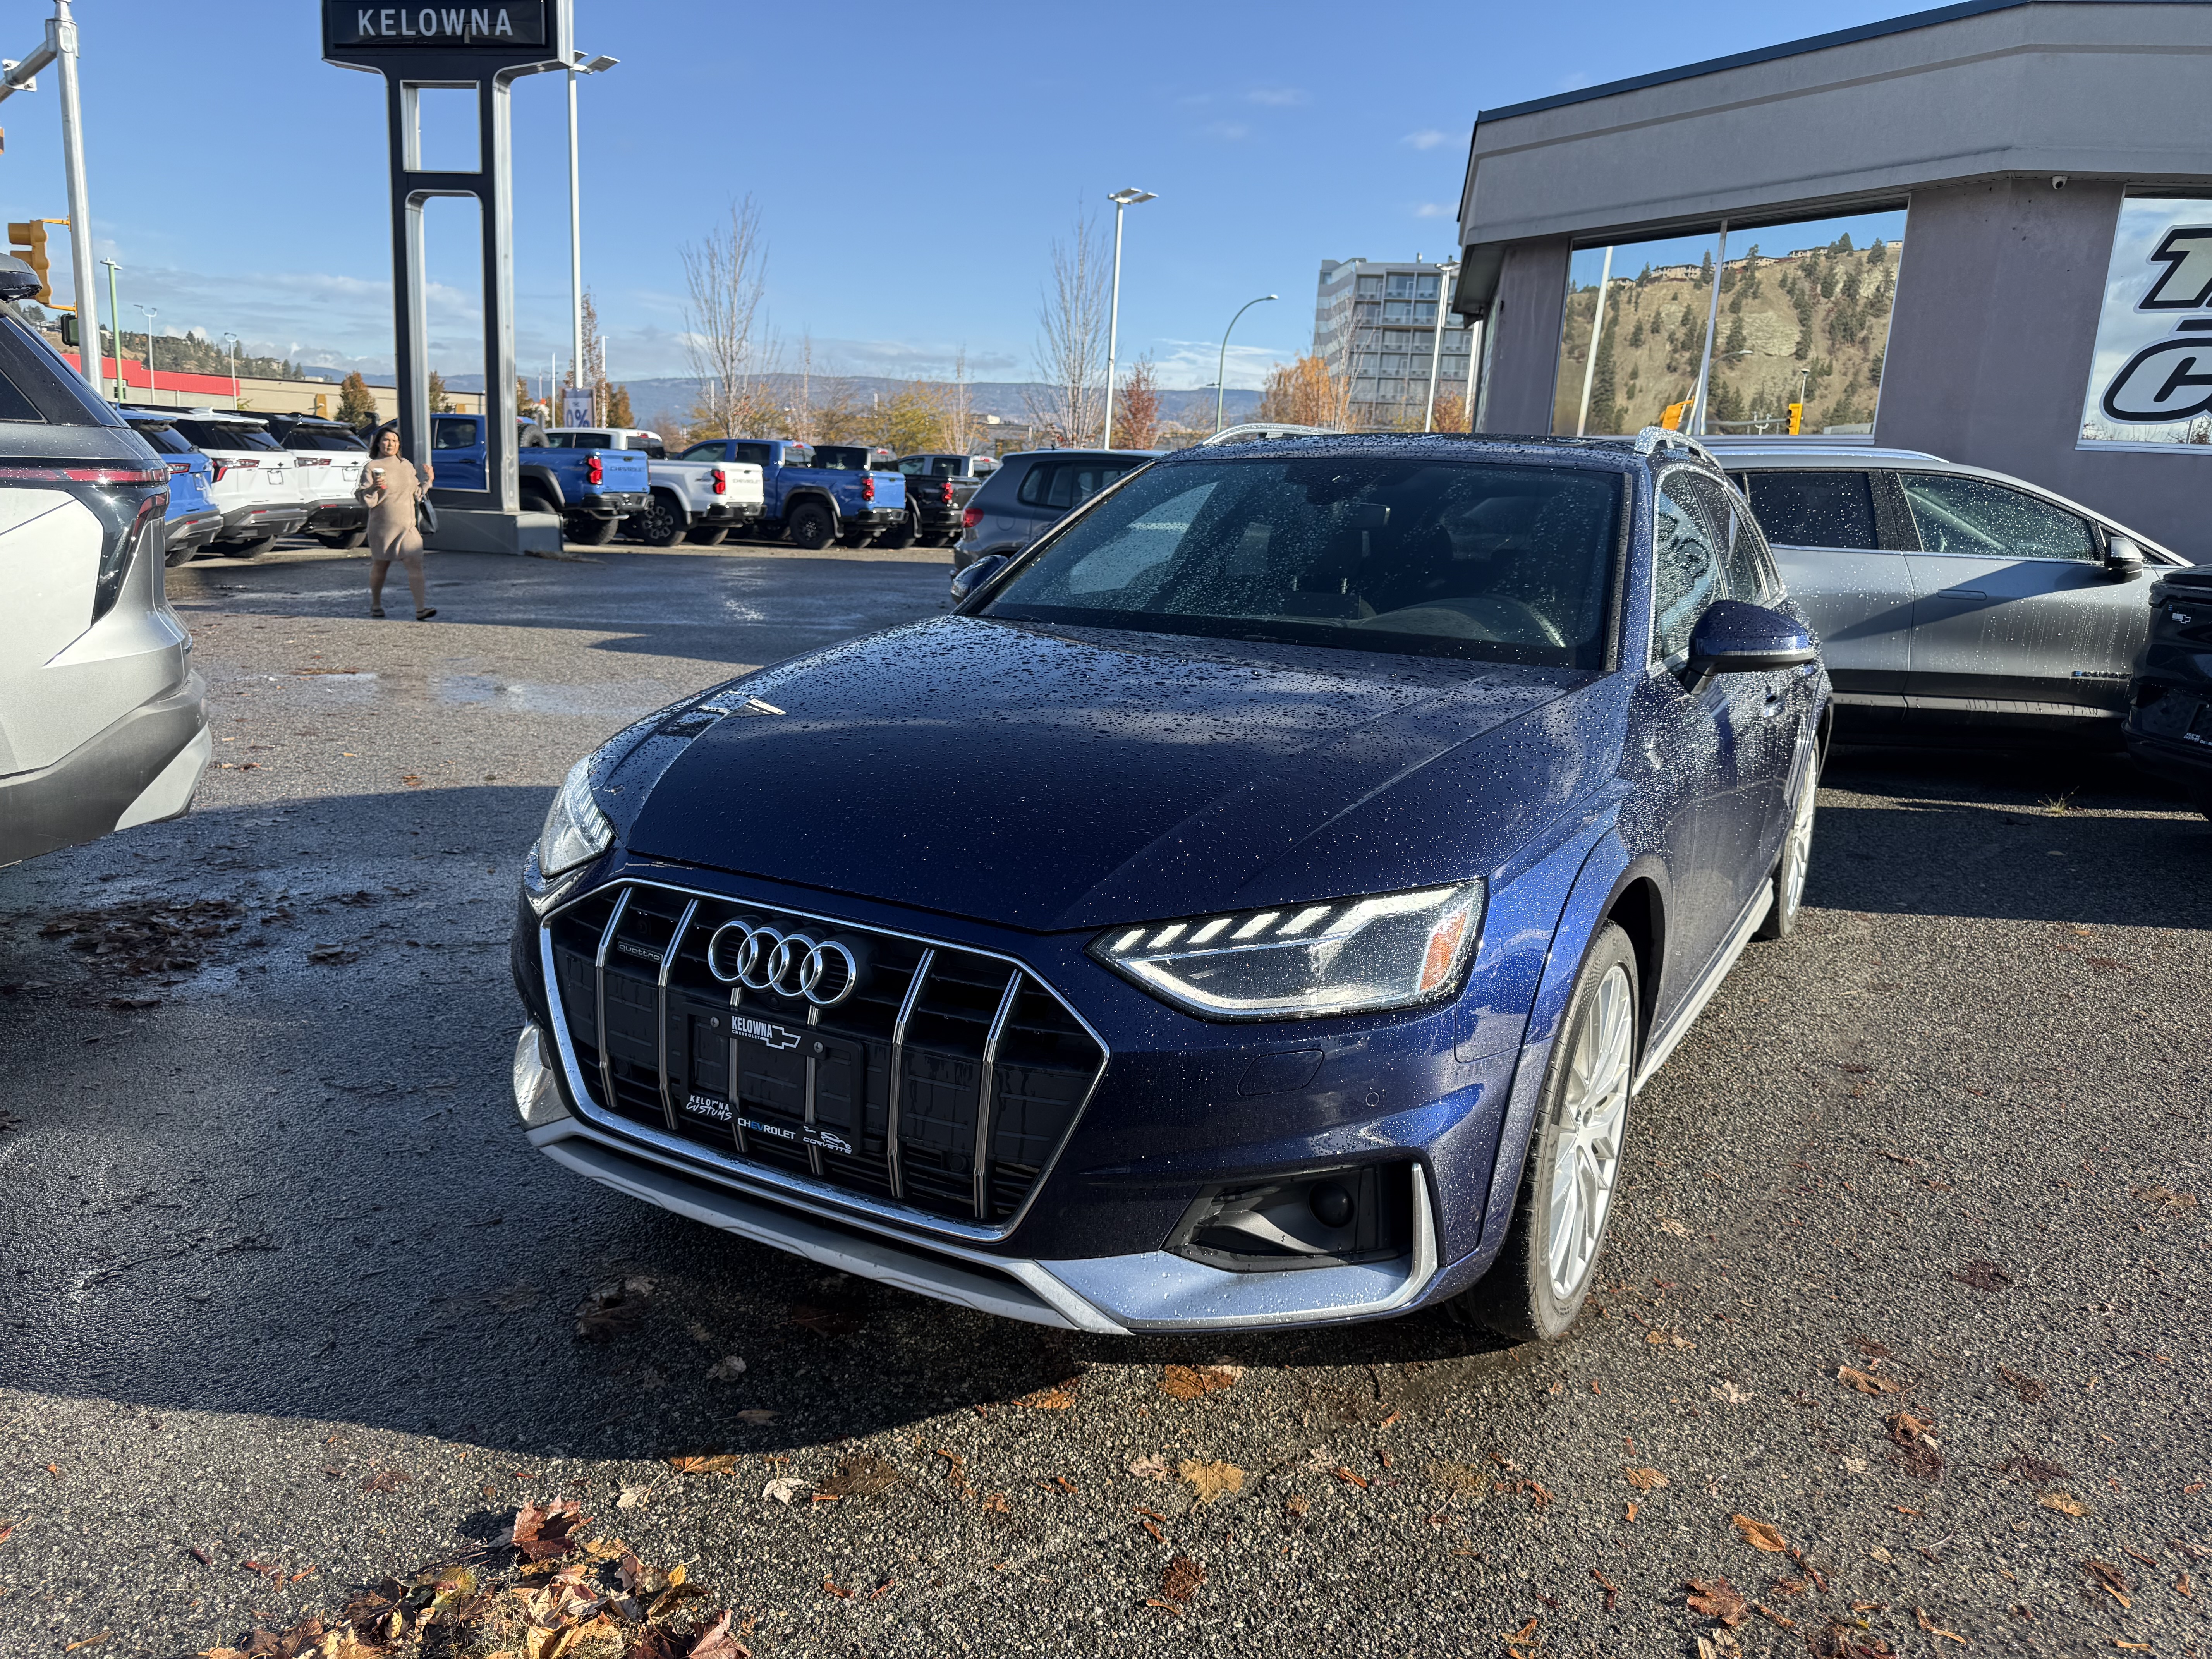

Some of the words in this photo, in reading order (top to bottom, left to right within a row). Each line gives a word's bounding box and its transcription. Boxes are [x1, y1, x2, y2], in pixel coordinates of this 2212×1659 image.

[358, 9, 513, 36] KELOWNA
[619, 944, 660, 961] quattro
[732, 1015, 773, 1038] KELOWNA
[732, 1030, 761, 1040] CHEVROLET
[737, 1118, 796, 1140] CHEVROLET
[803, 1137, 852, 1154] CORVETTE
